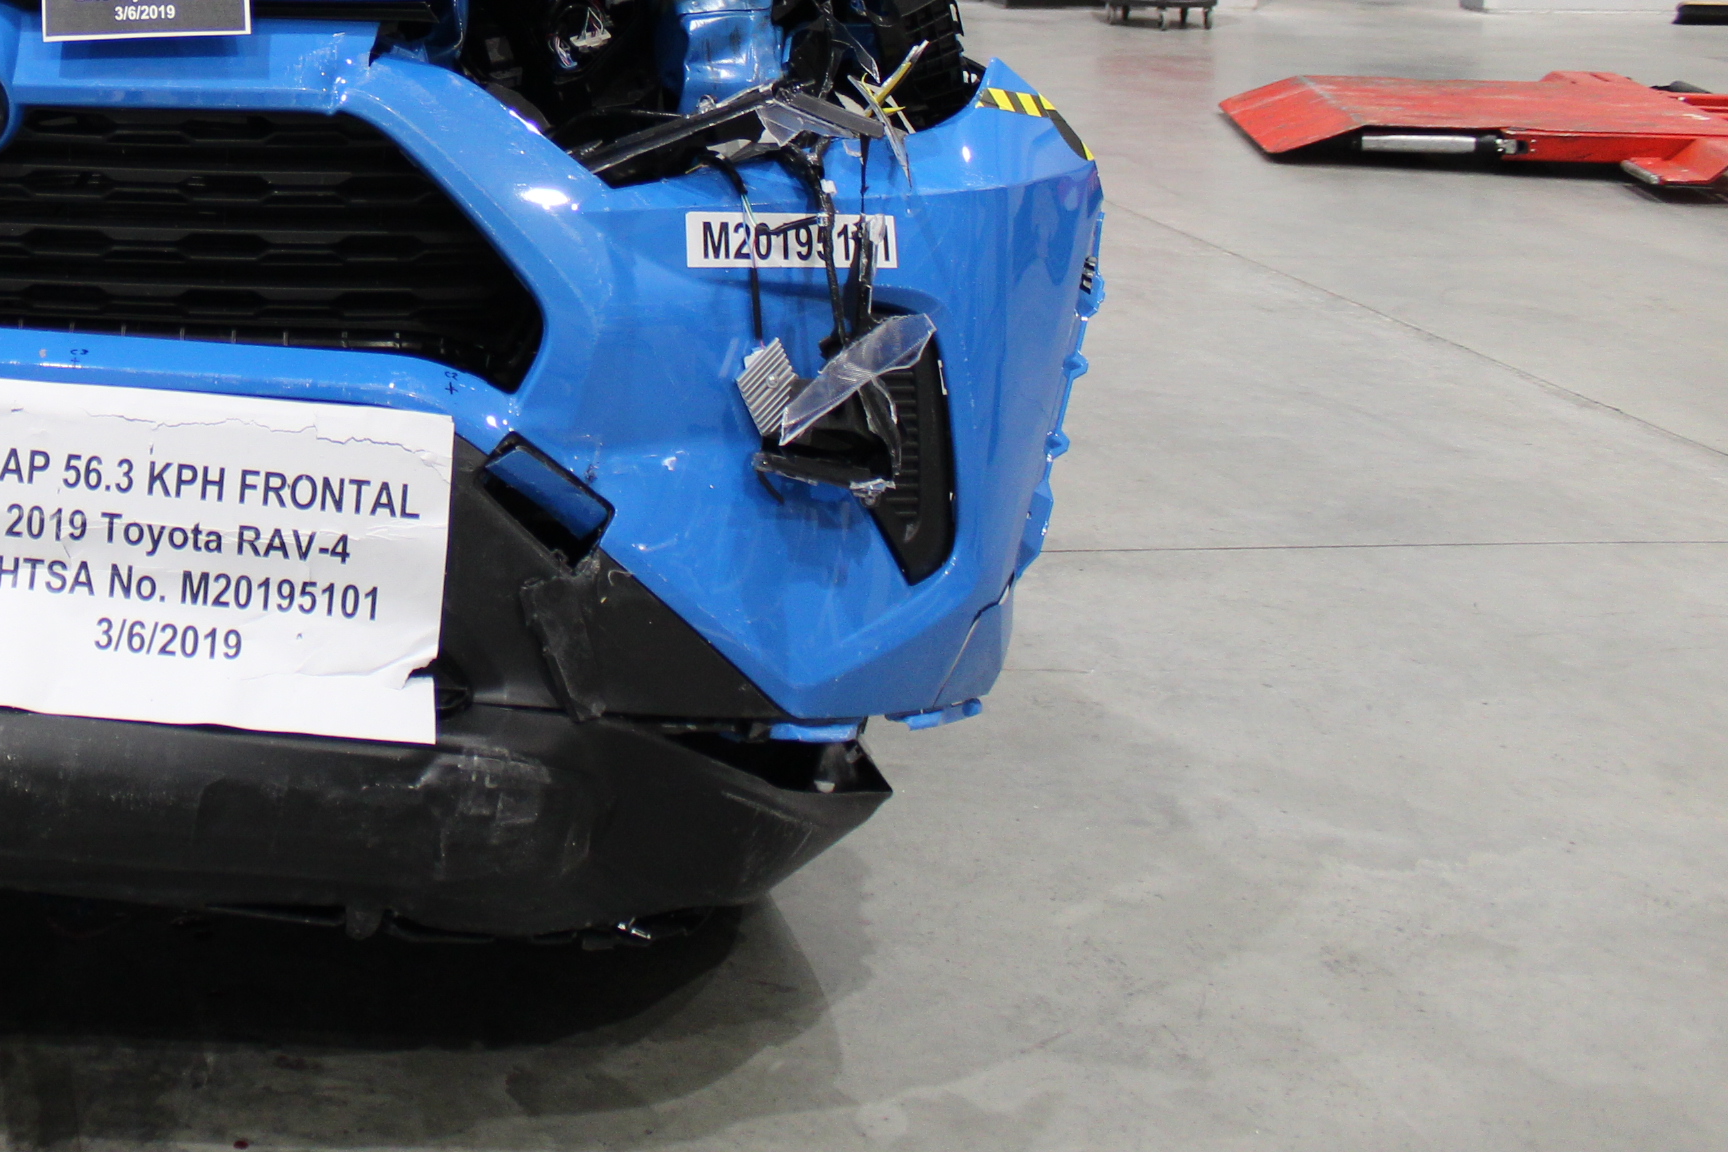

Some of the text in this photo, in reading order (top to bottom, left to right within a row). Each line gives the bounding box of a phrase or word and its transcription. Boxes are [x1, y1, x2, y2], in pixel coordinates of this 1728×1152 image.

[115, 5, 175, 20] 3/6/2019
[63, 454, 133, 493] 56.3
[148, 461, 225, 501] KPH
[240, 470, 419, 518] FRONTAL
[6, 504, 350, 564] 2019 Toyota RAV-4
[110, 564, 164, 601] No.
[182, 571, 377, 620] M20195101
[96, 618, 241, 660] 3/6/2019
